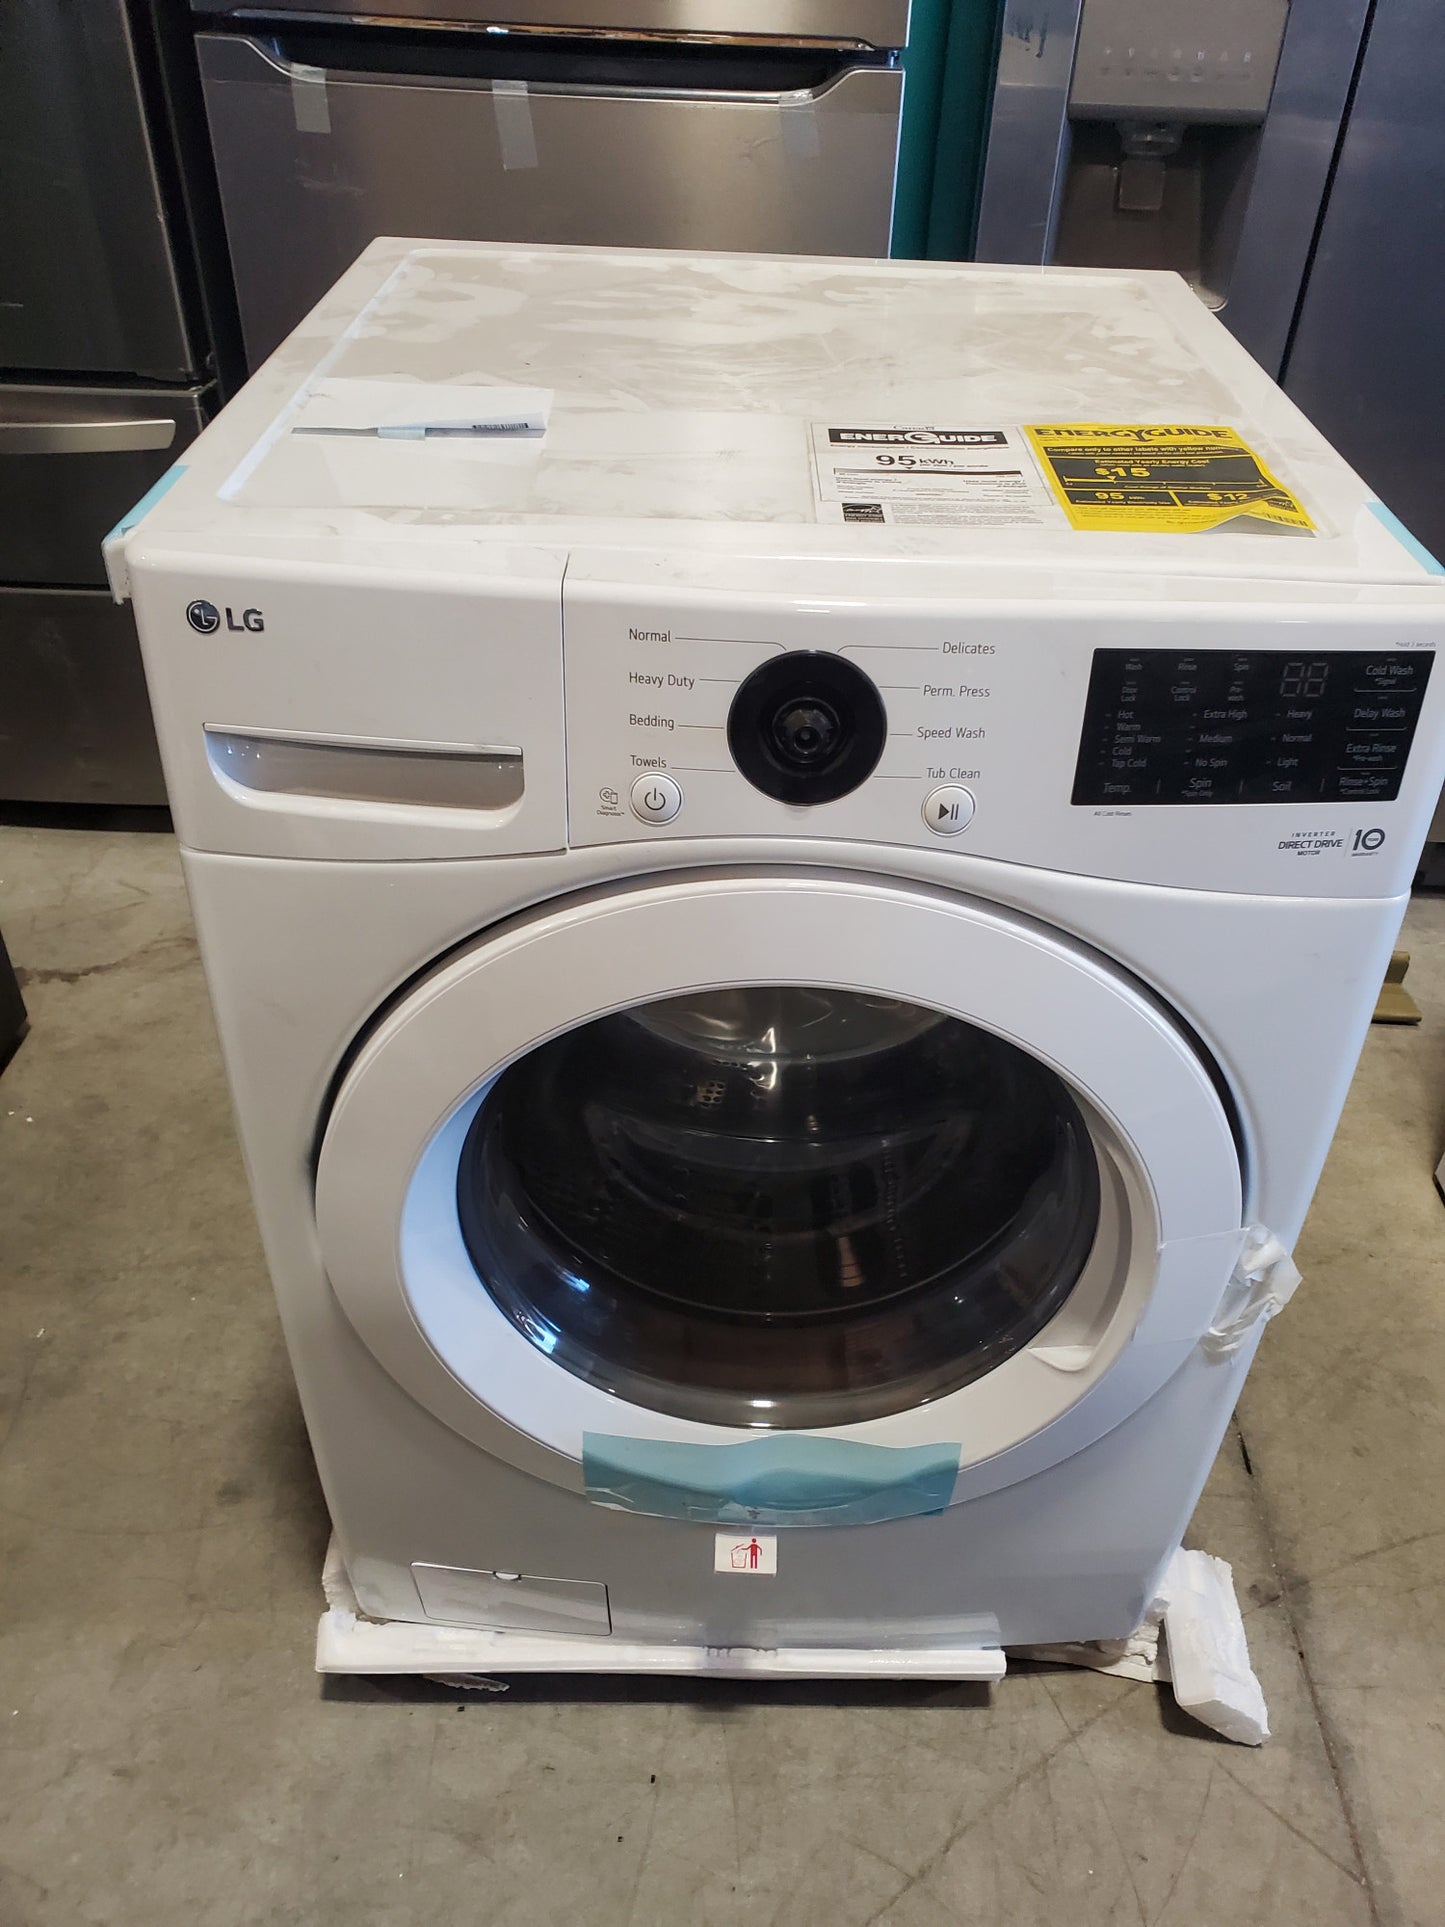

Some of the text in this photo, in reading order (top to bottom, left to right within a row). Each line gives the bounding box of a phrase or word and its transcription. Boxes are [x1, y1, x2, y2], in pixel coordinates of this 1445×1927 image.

[840, 431, 998, 444] ENERGUIDE
[1035, 428, 1232, 442] ENERGYGUIDE
[876, 455, 916, 466] 95
[1094, 467, 1151, 477] $15
[1095, 492, 1125, 500] 95
[225, 607, 264, 631] LG
[629, 628, 671, 642] Normal
[942, 641, 996, 655] Delicates
[1366, 665, 1414, 676] Cold Wash
[629, 672, 696, 690] Heavy Duty
[923, 684, 991, 697] Perm. Press
[1118, 710, 1135, 719] Hot
[1203, 710, 1248, 720] Extra High
[1287, 709, 1313, 720] Heavy
[1354, 708, 1406, 720] Delay Wash
[629, 714, 675, 731] Bedding
[917, 726, 986, 740] Speed Wash
[1200, 734, 1233, 743] Medium
[1282, 734, 1312, 742] Normal
[1112, 747, 1132, 755] Cold
[1346, 744, 1397, 753] Extra Rinse
[630, 754, 667, 768] Towels
[1127, 759, 1147, 768] Cold
[1195, 759, 1228, 768] No Spin
[1277, 757, 1299, 768] Light
[926, 767, 981, 779] Tub Clean
[1104, 782, 1132, 795] Temp.
[1189, 778, 1213, 789] Spin
[1272, 781, 1292, 791] Soil
[1291, 830, 1336, 838] INVERTER
[1278, 839, 1344, 850] DIRECT DRIVE
